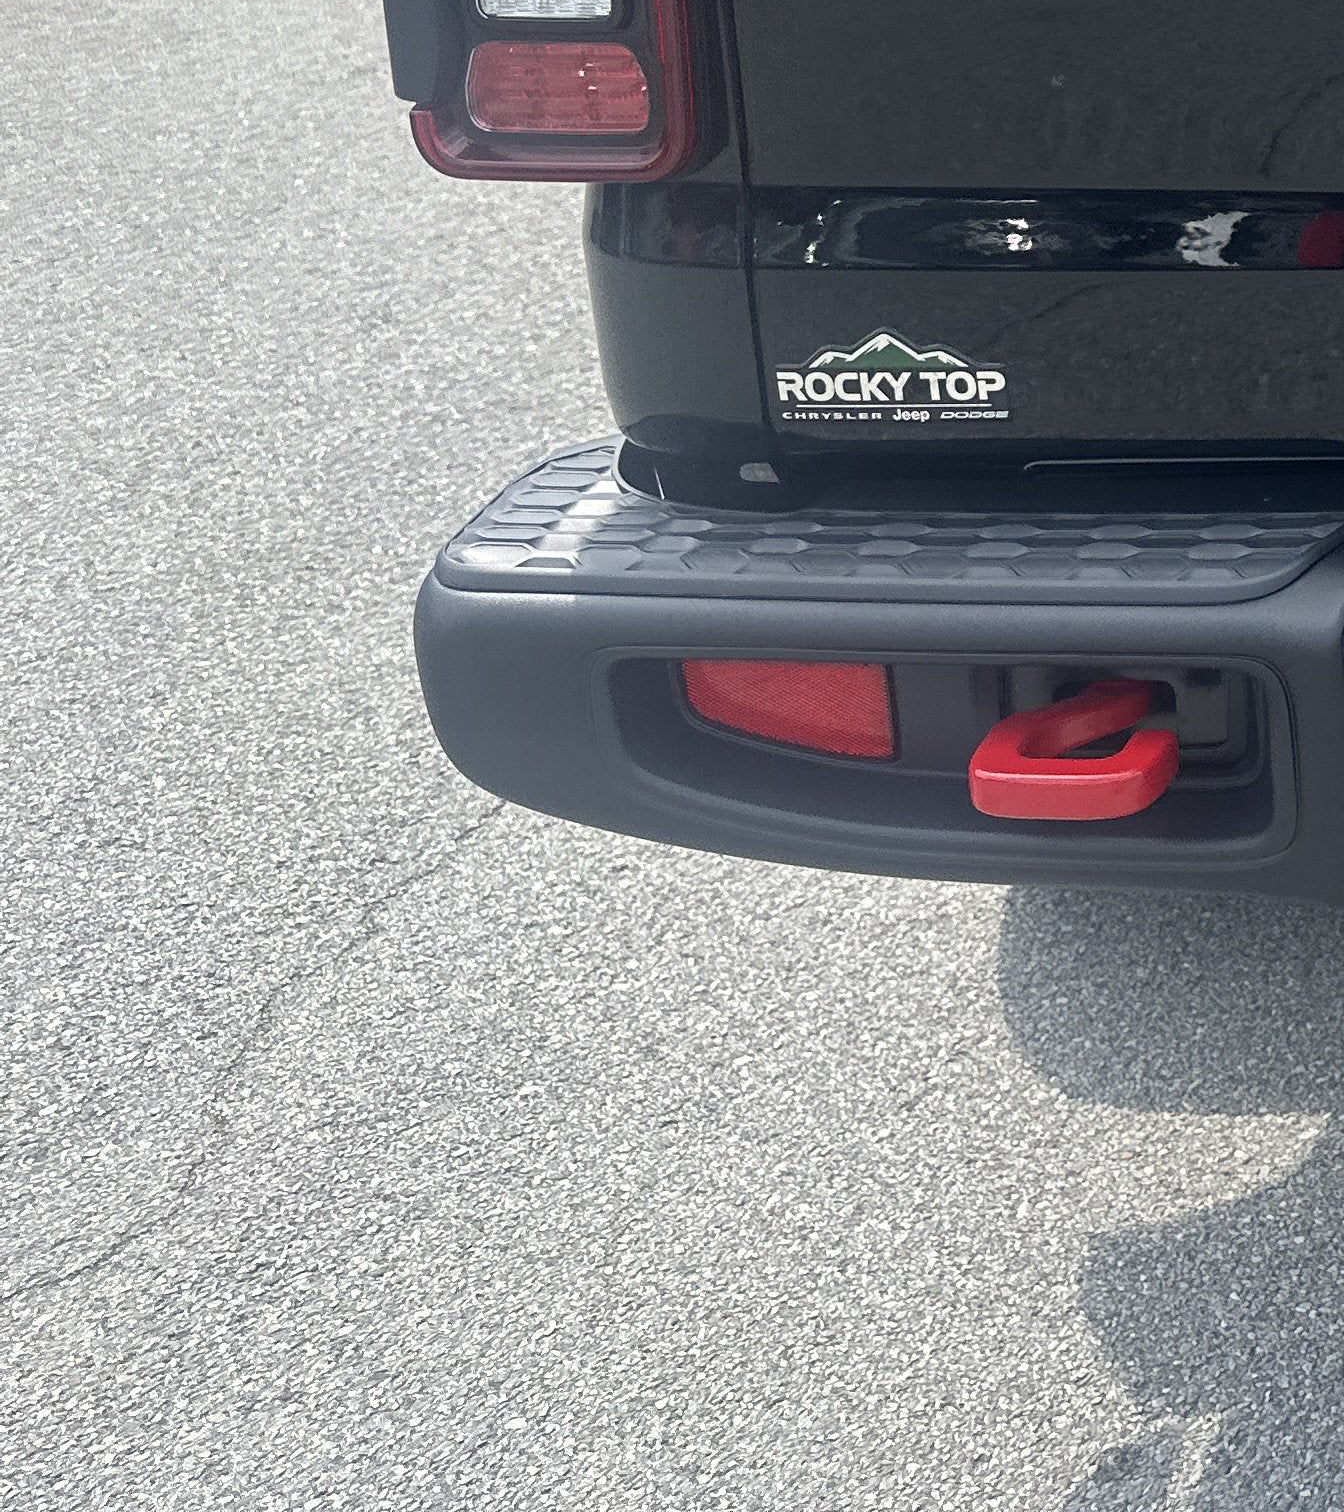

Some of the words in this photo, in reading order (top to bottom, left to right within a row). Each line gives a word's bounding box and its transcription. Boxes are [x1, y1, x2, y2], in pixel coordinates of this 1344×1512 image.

[775, 371, 912, 402] ROCKY
[919, 370, 1006, 401] TOP
[781, 411, 882, 420] CHRYSLER
[892, 408, 931, 423] Jeep
[939, 410, 1009, 420] DODGE
